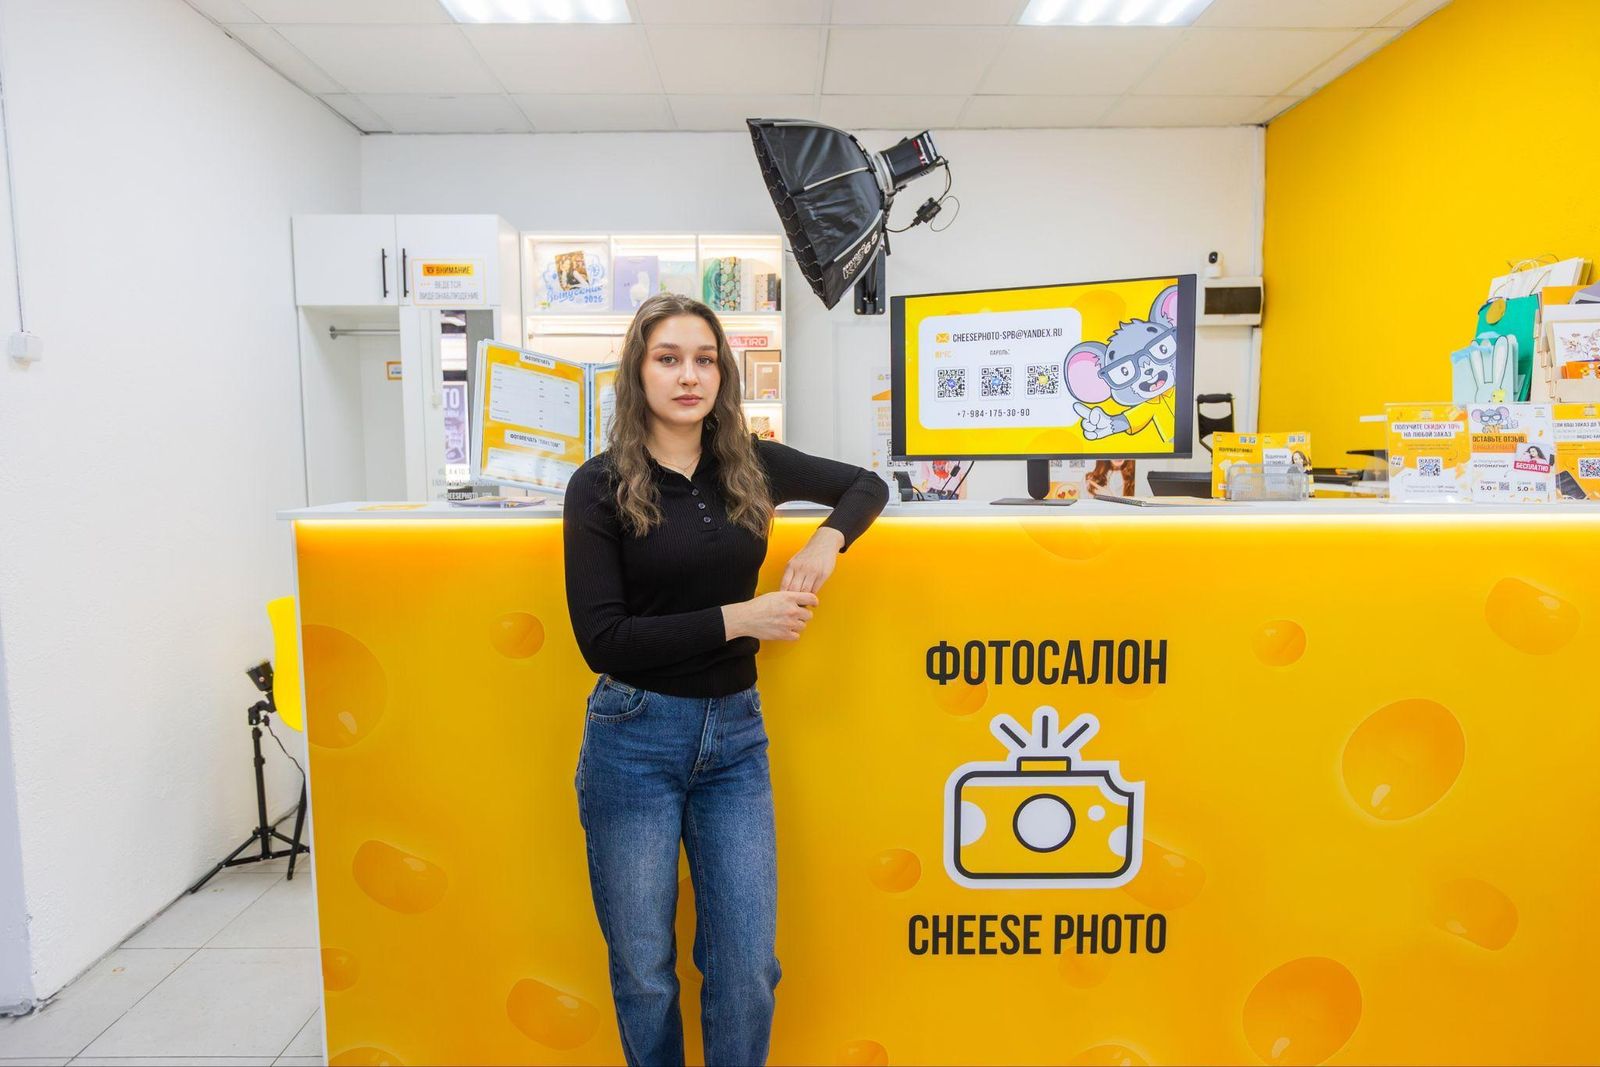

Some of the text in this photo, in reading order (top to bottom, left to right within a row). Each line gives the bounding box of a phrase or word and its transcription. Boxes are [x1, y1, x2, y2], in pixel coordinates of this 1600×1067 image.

[436, 266, 471, 274] ВНИМАНИЕ
[584, 295, 603, 303] 2026
[952, 328, 1063, 343] CHEESEPHOTO-SPB@YANDEX.RU
[957, 408, 1031, 418] +7-984-175-30-90
[1472, 435, 1525, 443] ОСТАВЬТЕ ОТЗЫВ
[1515, 462, 1549, 472] БЕСПЛАТНО
[925, 638, 1168, 686] ФОТОСАЛОН
[907, 913, 1168, 956] CHEESE PHOTO
